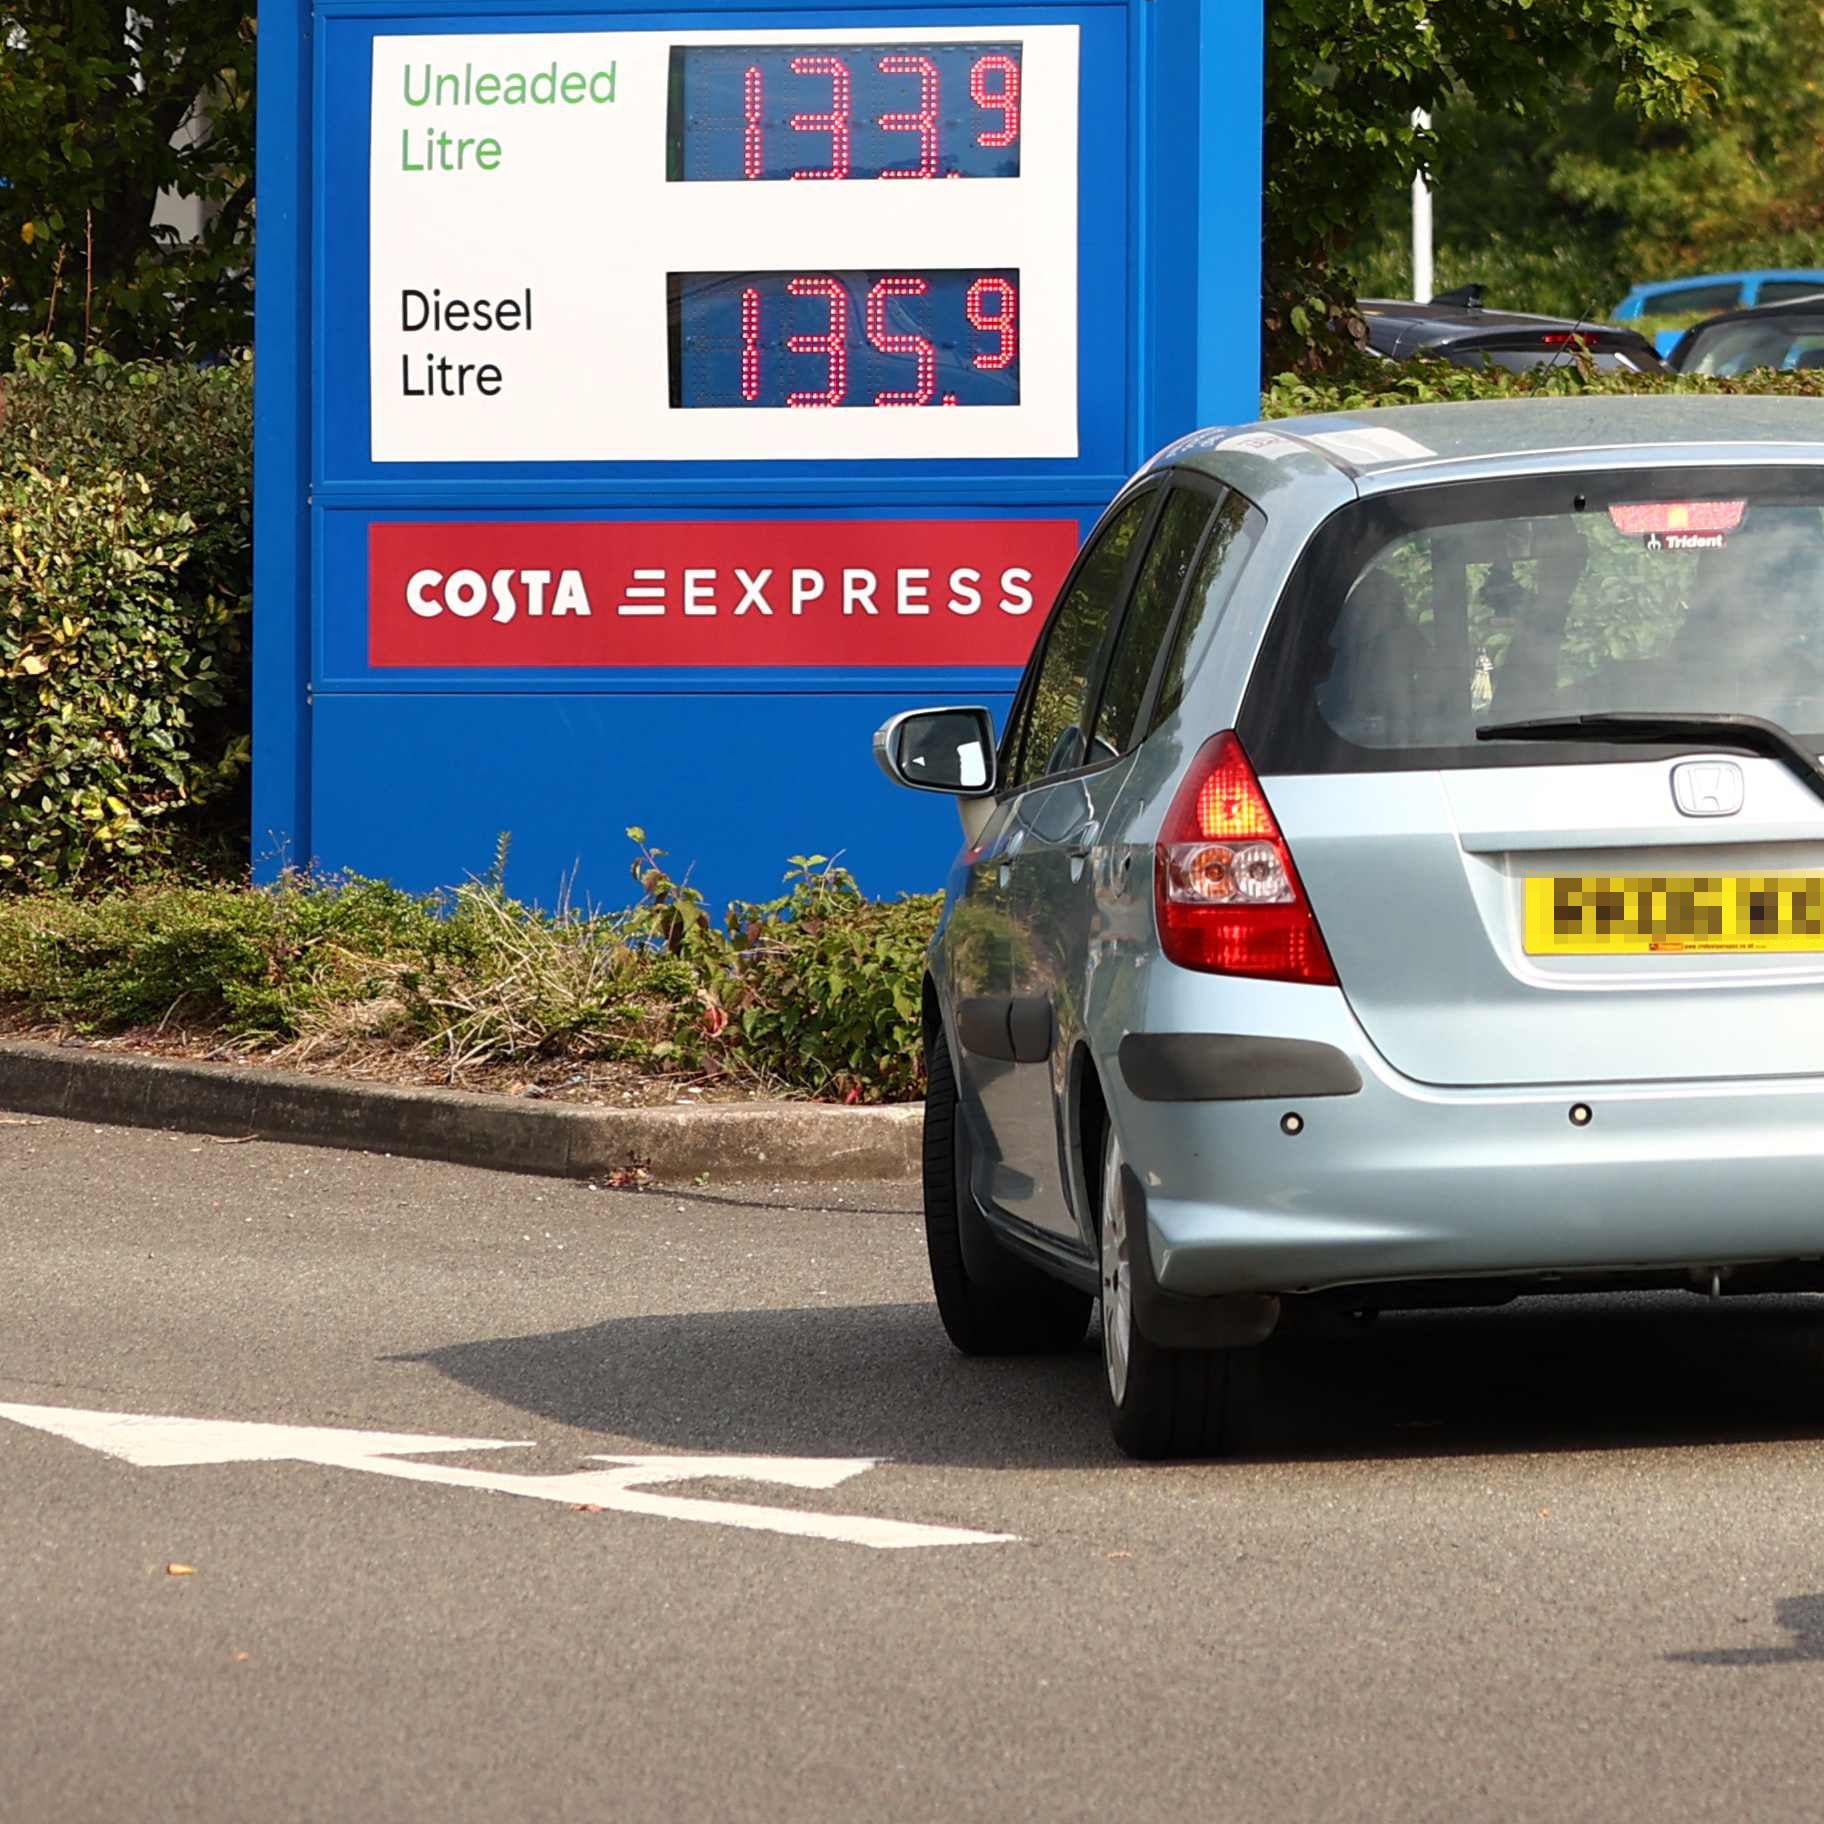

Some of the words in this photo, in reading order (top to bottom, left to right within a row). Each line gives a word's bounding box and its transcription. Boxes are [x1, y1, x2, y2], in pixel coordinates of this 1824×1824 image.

[402, 60, 618, 107] Unleaded
[401, 128, 503, 172] Litre
[401, 288, 533, 332] Diesel
[401, 353, 503, 396] Litre
[1666, 535, 1723, 548] Trident
[405, 569, 592, 623] COSTA
[683, 568, 1034, 615] EXPRESS
